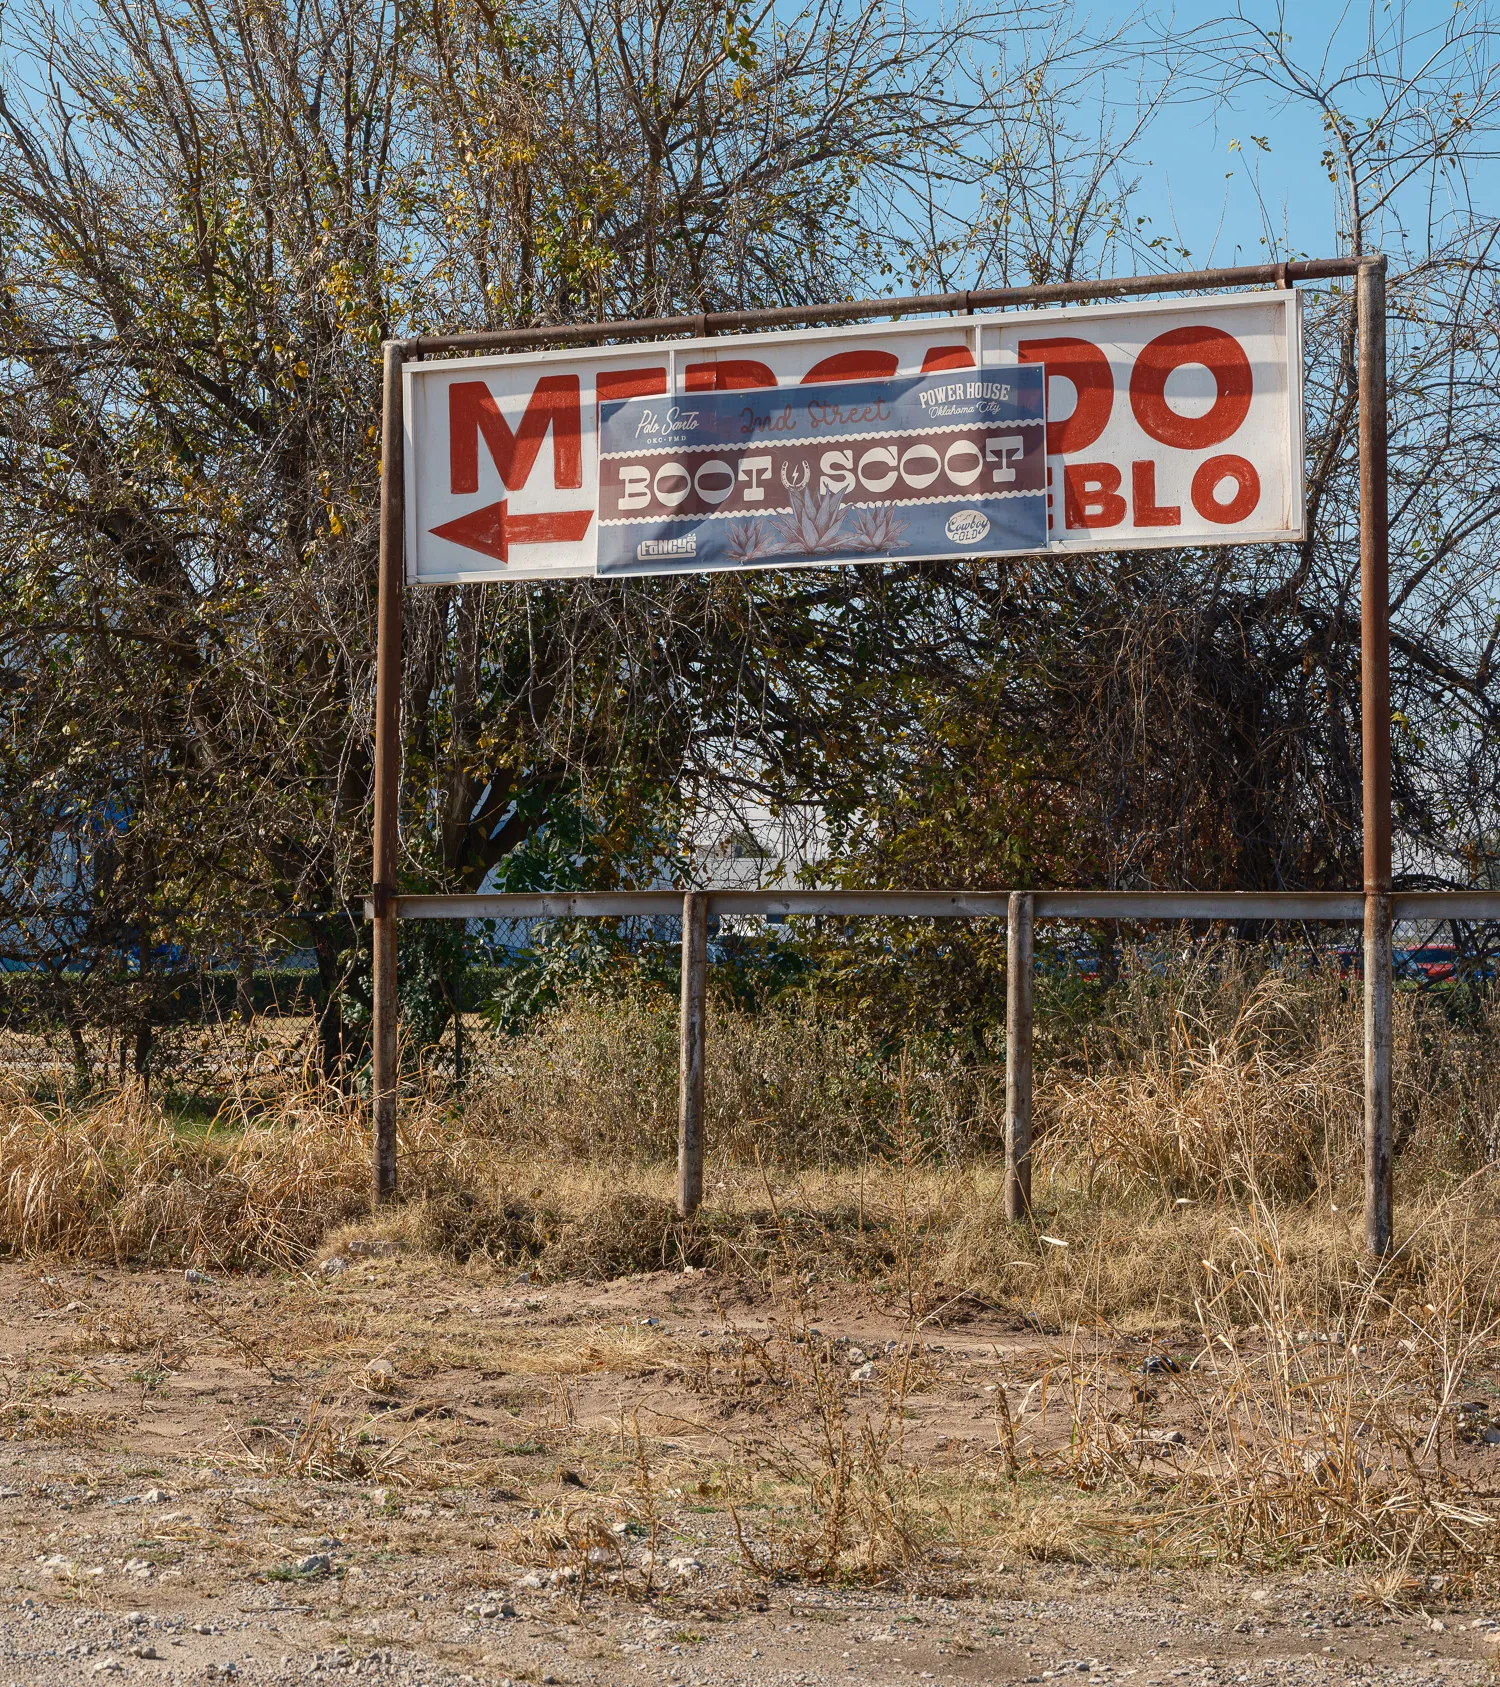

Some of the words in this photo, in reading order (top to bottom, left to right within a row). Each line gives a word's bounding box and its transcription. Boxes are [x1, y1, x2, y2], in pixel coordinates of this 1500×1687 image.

[918, 383, 964, 409] POWER
[966, 381, 1011, 401] HOUSE
[928, 404, 975, 419] Oklahoma
[975, 401, 1001, 415] City
[635, 409, 660, 439] Palo
[661, 406, 700, 436] Santo
[740, 403, 797, 434] 2nd
[807, 395, 891, 429] Street
[617, 455, 772, 510] BOOT
[819, 435, 1024, 496] SCOOT
[1047, 453, 1261, 530] BLO
[947, 514, 989, 535] Cowboy
